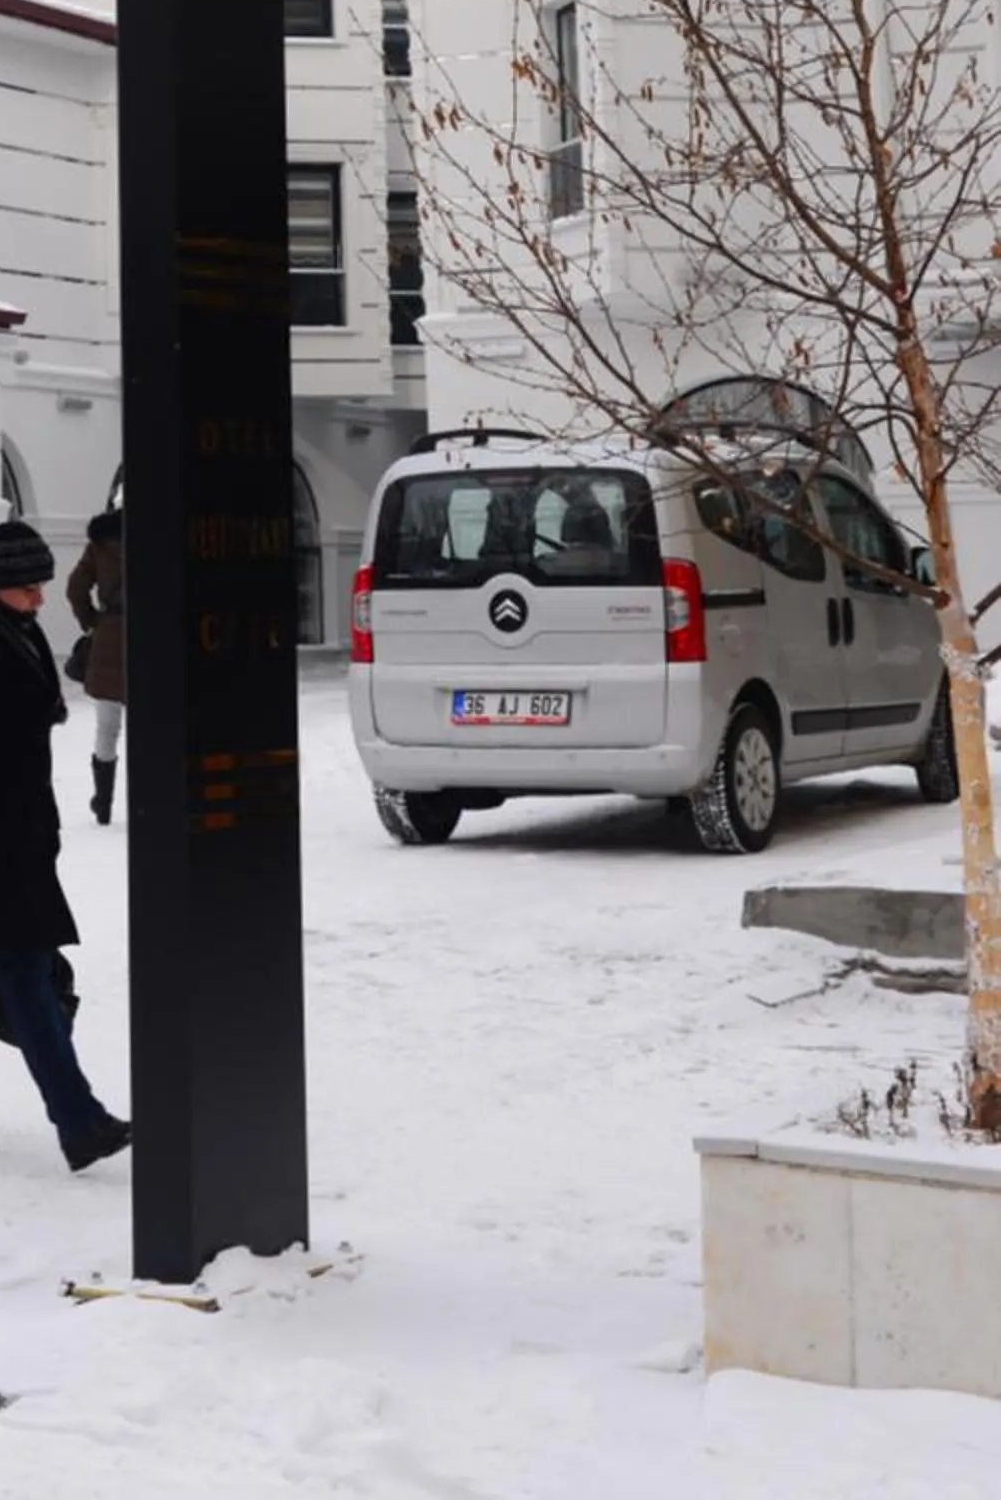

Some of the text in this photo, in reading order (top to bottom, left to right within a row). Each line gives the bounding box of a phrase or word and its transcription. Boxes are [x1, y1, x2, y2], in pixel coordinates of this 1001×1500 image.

[465, 695, 564, 717] 36 AJ 602
